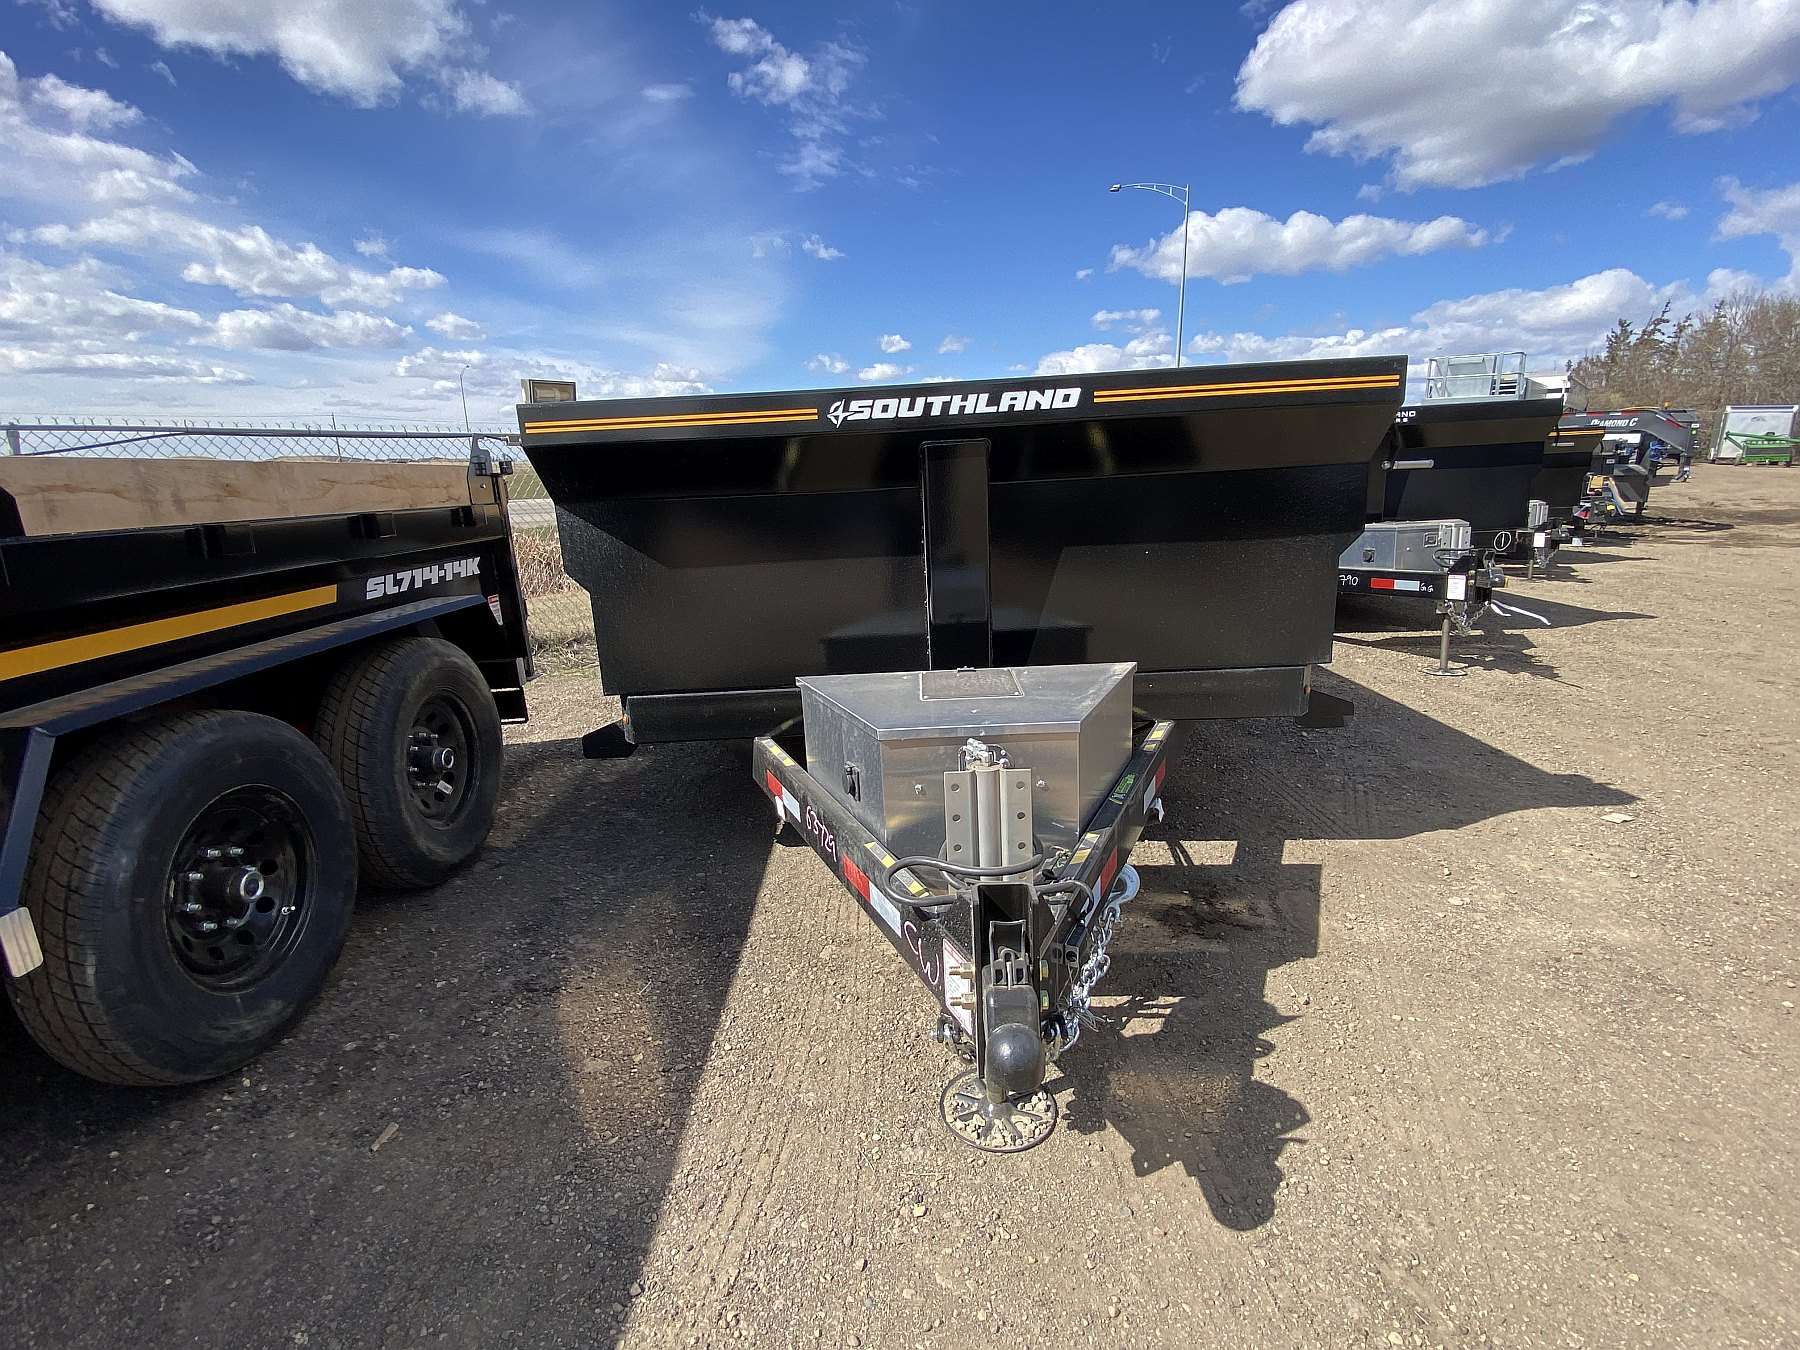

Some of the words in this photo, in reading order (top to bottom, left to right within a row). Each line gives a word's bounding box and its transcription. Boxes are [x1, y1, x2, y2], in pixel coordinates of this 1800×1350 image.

[847, 387, 1082, 421] SOUTHLAND
[1590, 418, 1629, 428] DIAMOND
[1629, 417, 1639, 427] C
[366, 556, 481, 600] SL714-14K
[1338, 574, 1359, 586] 790
